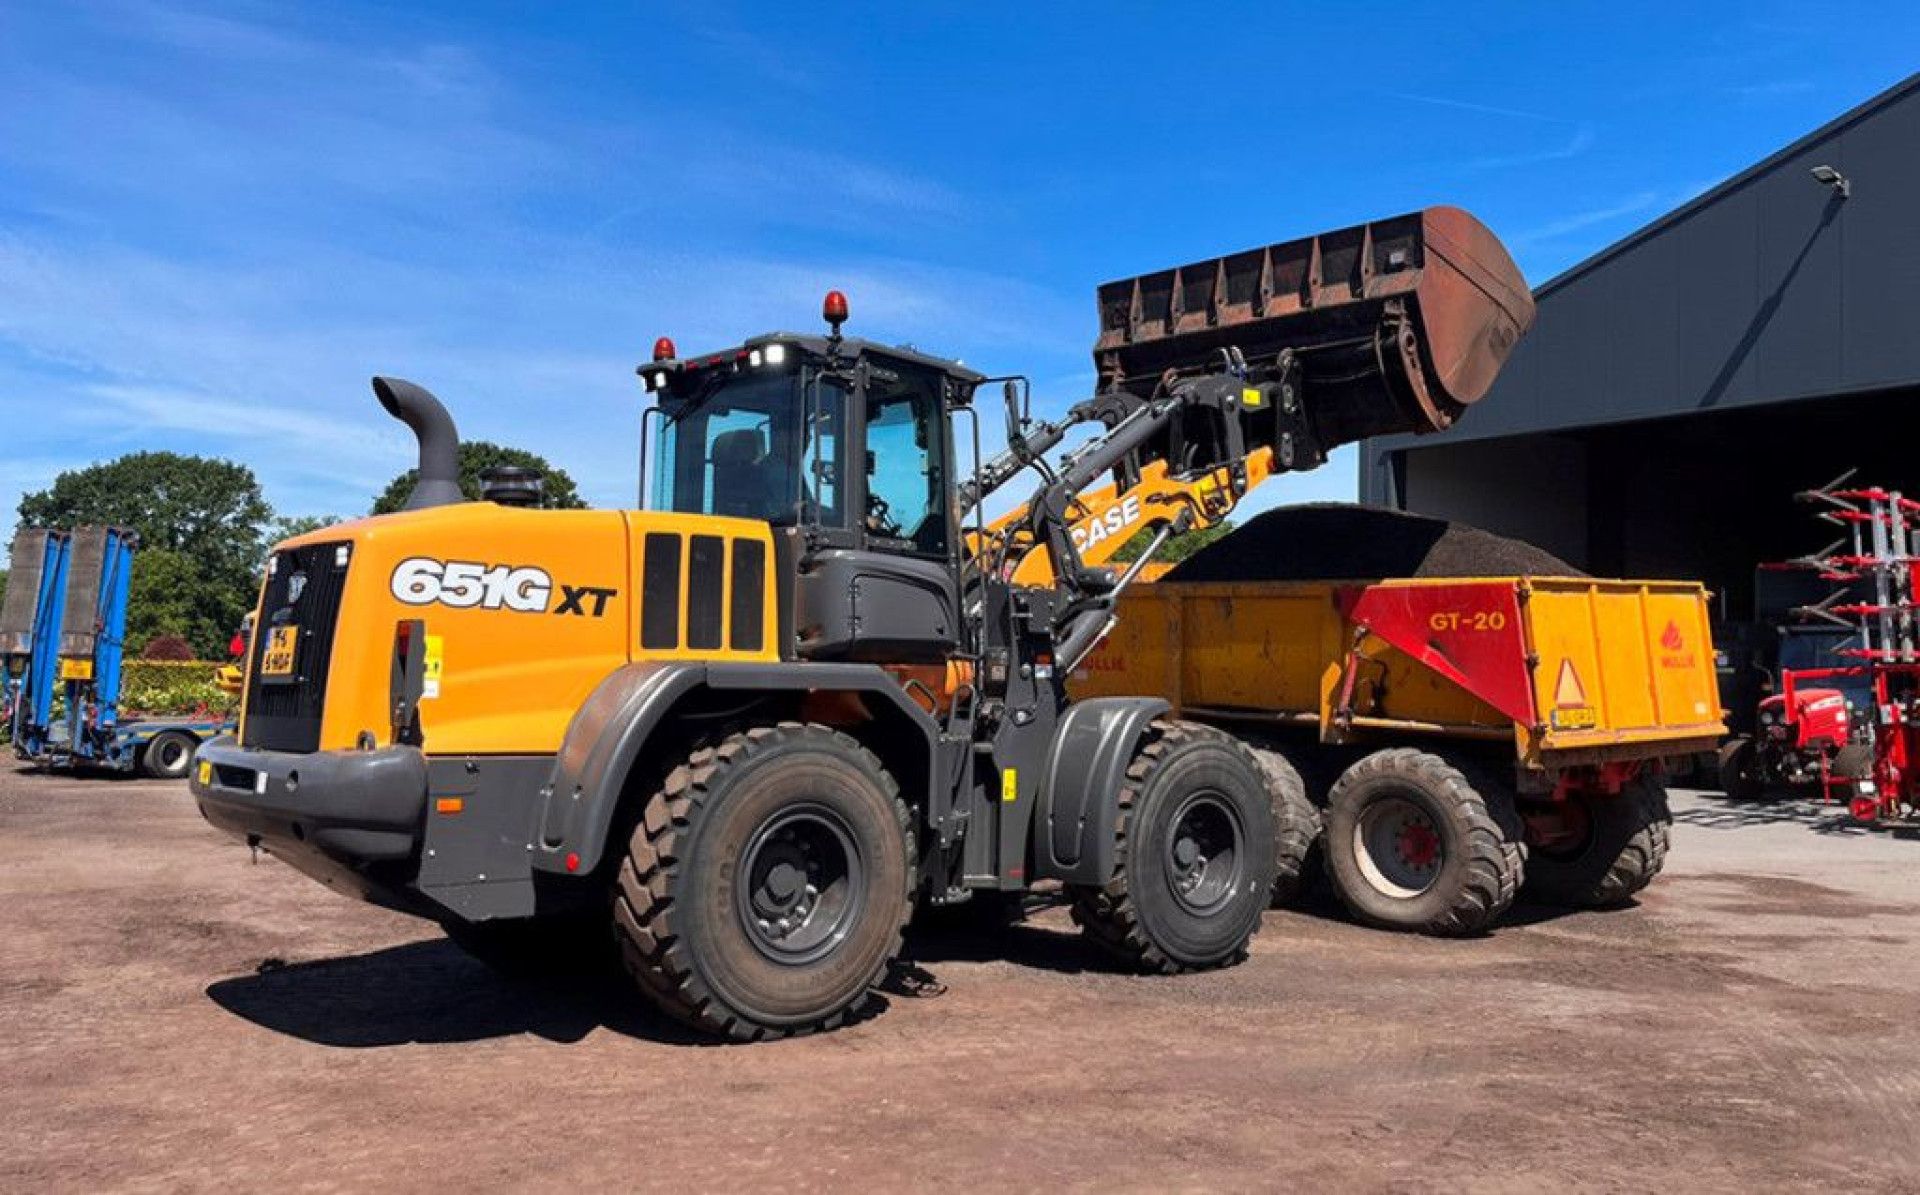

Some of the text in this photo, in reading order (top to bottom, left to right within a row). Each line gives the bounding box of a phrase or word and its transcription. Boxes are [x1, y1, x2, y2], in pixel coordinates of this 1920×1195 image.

[1072, 495, 1140, 554] CASE
[390, 556, 618, 617] 651G XT
[1430, 611, 1505, 631] GT-20
